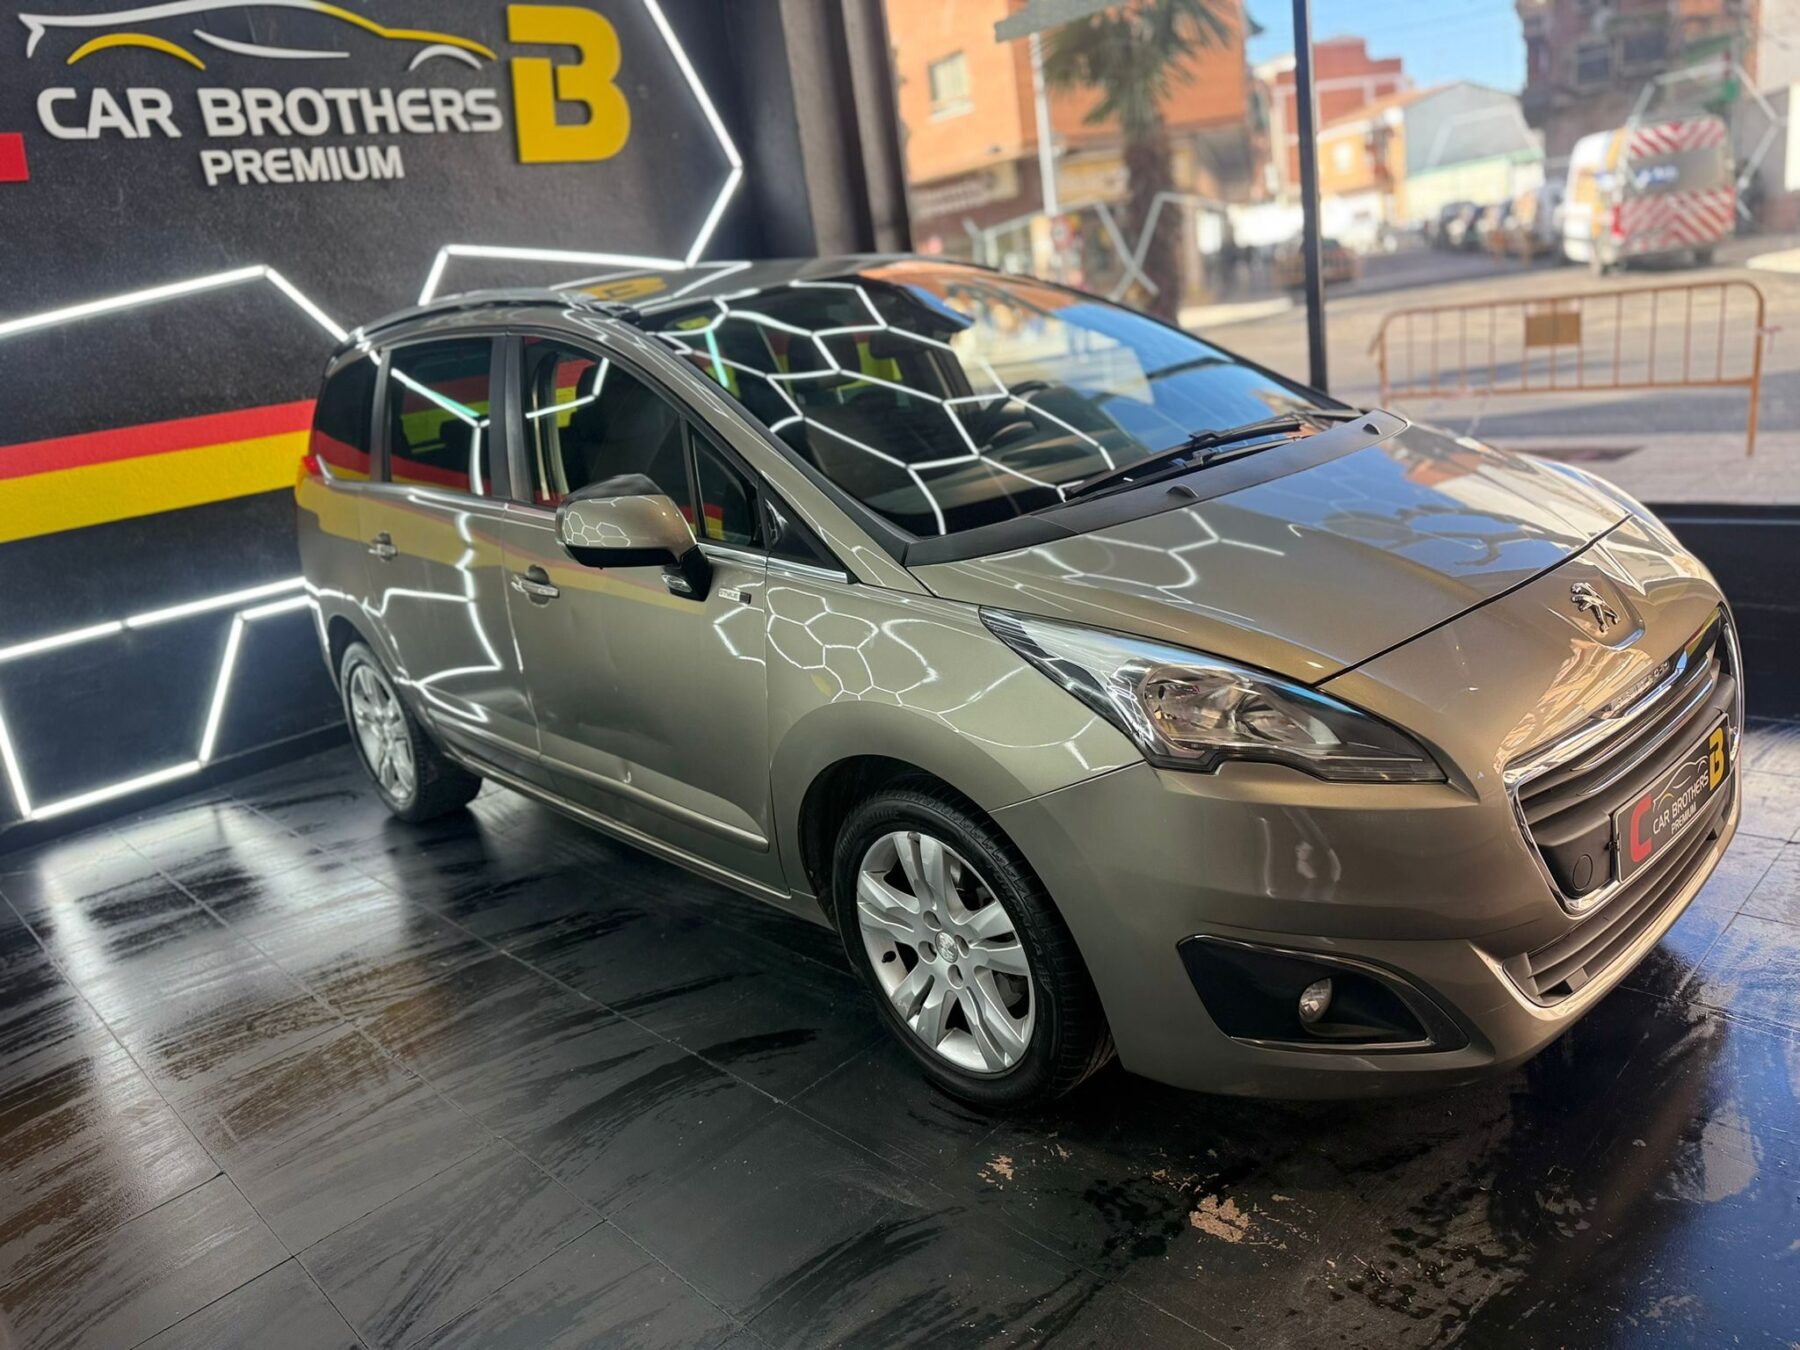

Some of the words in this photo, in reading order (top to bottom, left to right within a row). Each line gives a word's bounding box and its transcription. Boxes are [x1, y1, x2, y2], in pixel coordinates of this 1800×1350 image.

[506, 4, 632, 164] B
[37, 87, 182, 140] CAR
[199, 87, 504, 137] BROTHERS
[200, 146, 406, 187] PREMIUM
[1653, 809, 1670, 835] CAR
[1671, 769, 1709, 820] BROTHERS
[1671, 801, 1698, 835] PREMIUM
